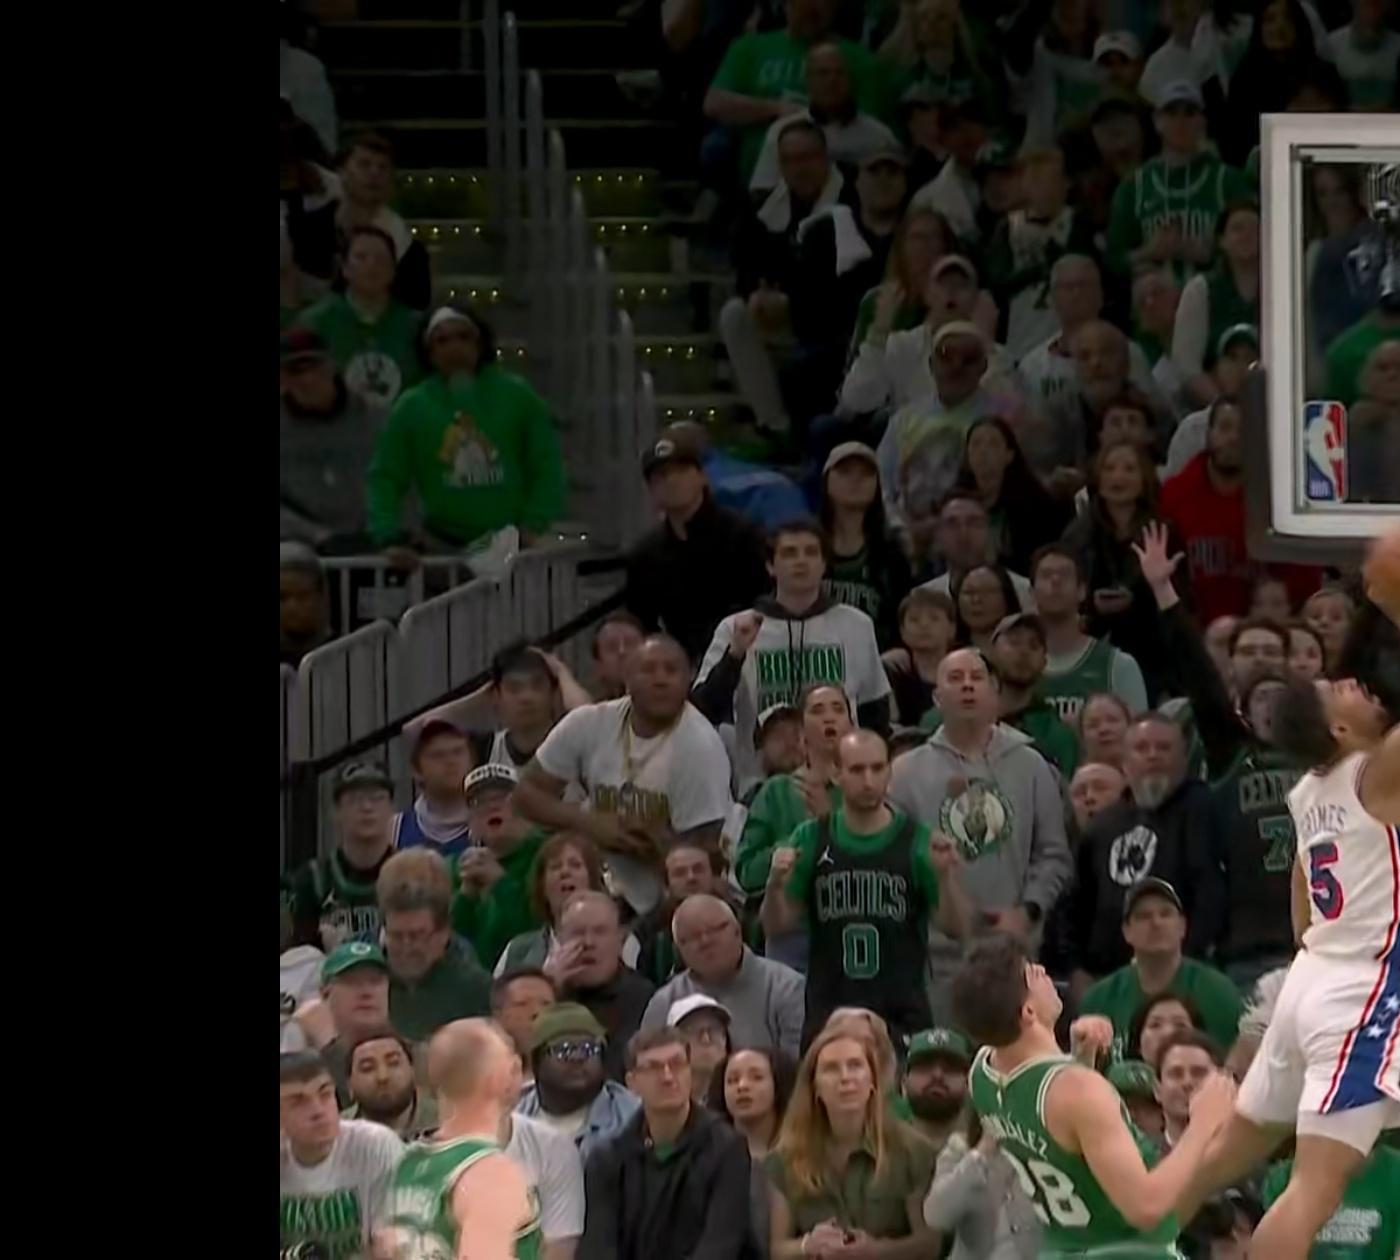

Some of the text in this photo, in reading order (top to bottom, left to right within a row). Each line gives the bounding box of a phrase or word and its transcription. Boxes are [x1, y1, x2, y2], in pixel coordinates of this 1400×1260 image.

[814, 869, 908, 923] CELTICS
[1310, 841, 1344, 920] 5
[842, 922, 880, 980] 0
